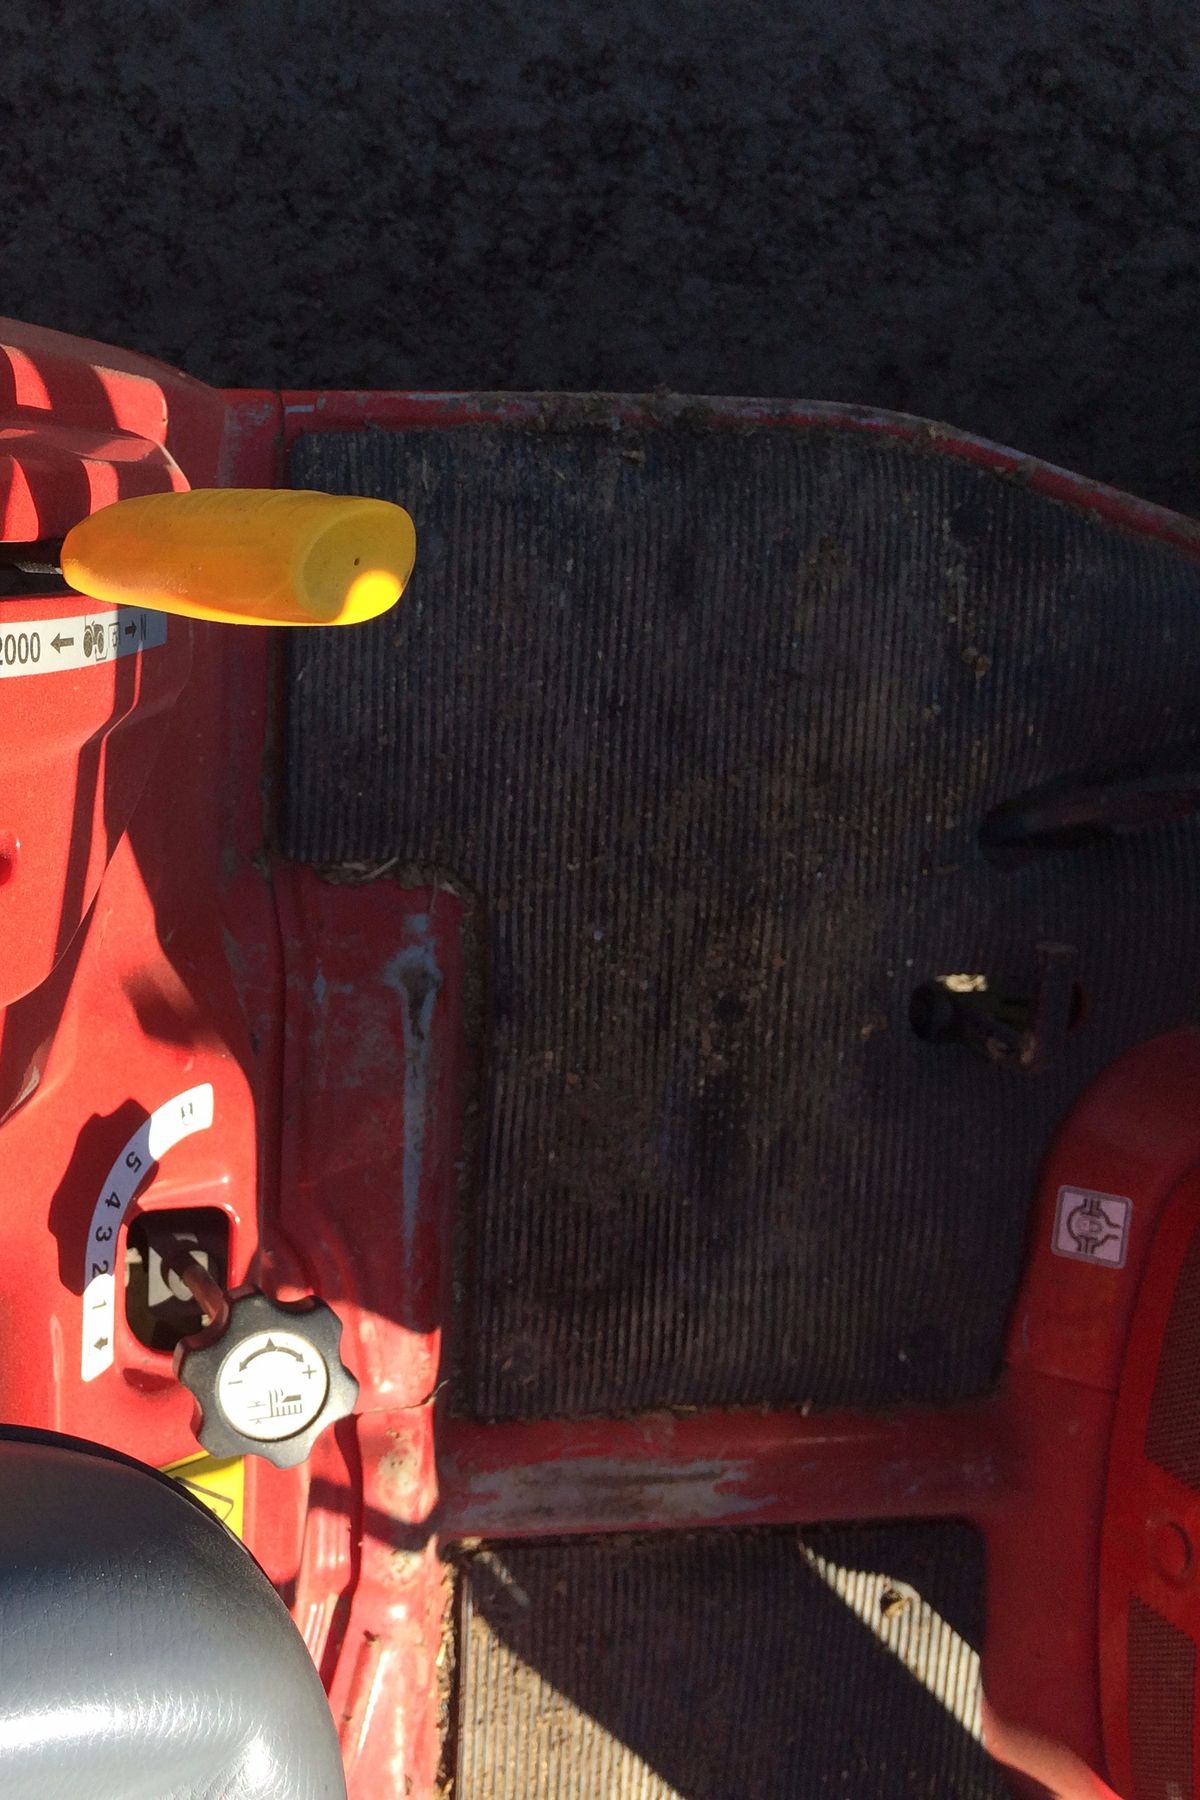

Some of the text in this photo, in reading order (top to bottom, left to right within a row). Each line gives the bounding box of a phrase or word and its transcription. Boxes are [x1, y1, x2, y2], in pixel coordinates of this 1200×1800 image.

[92, 1151, 142, 1310] 5 4 3 2 1
